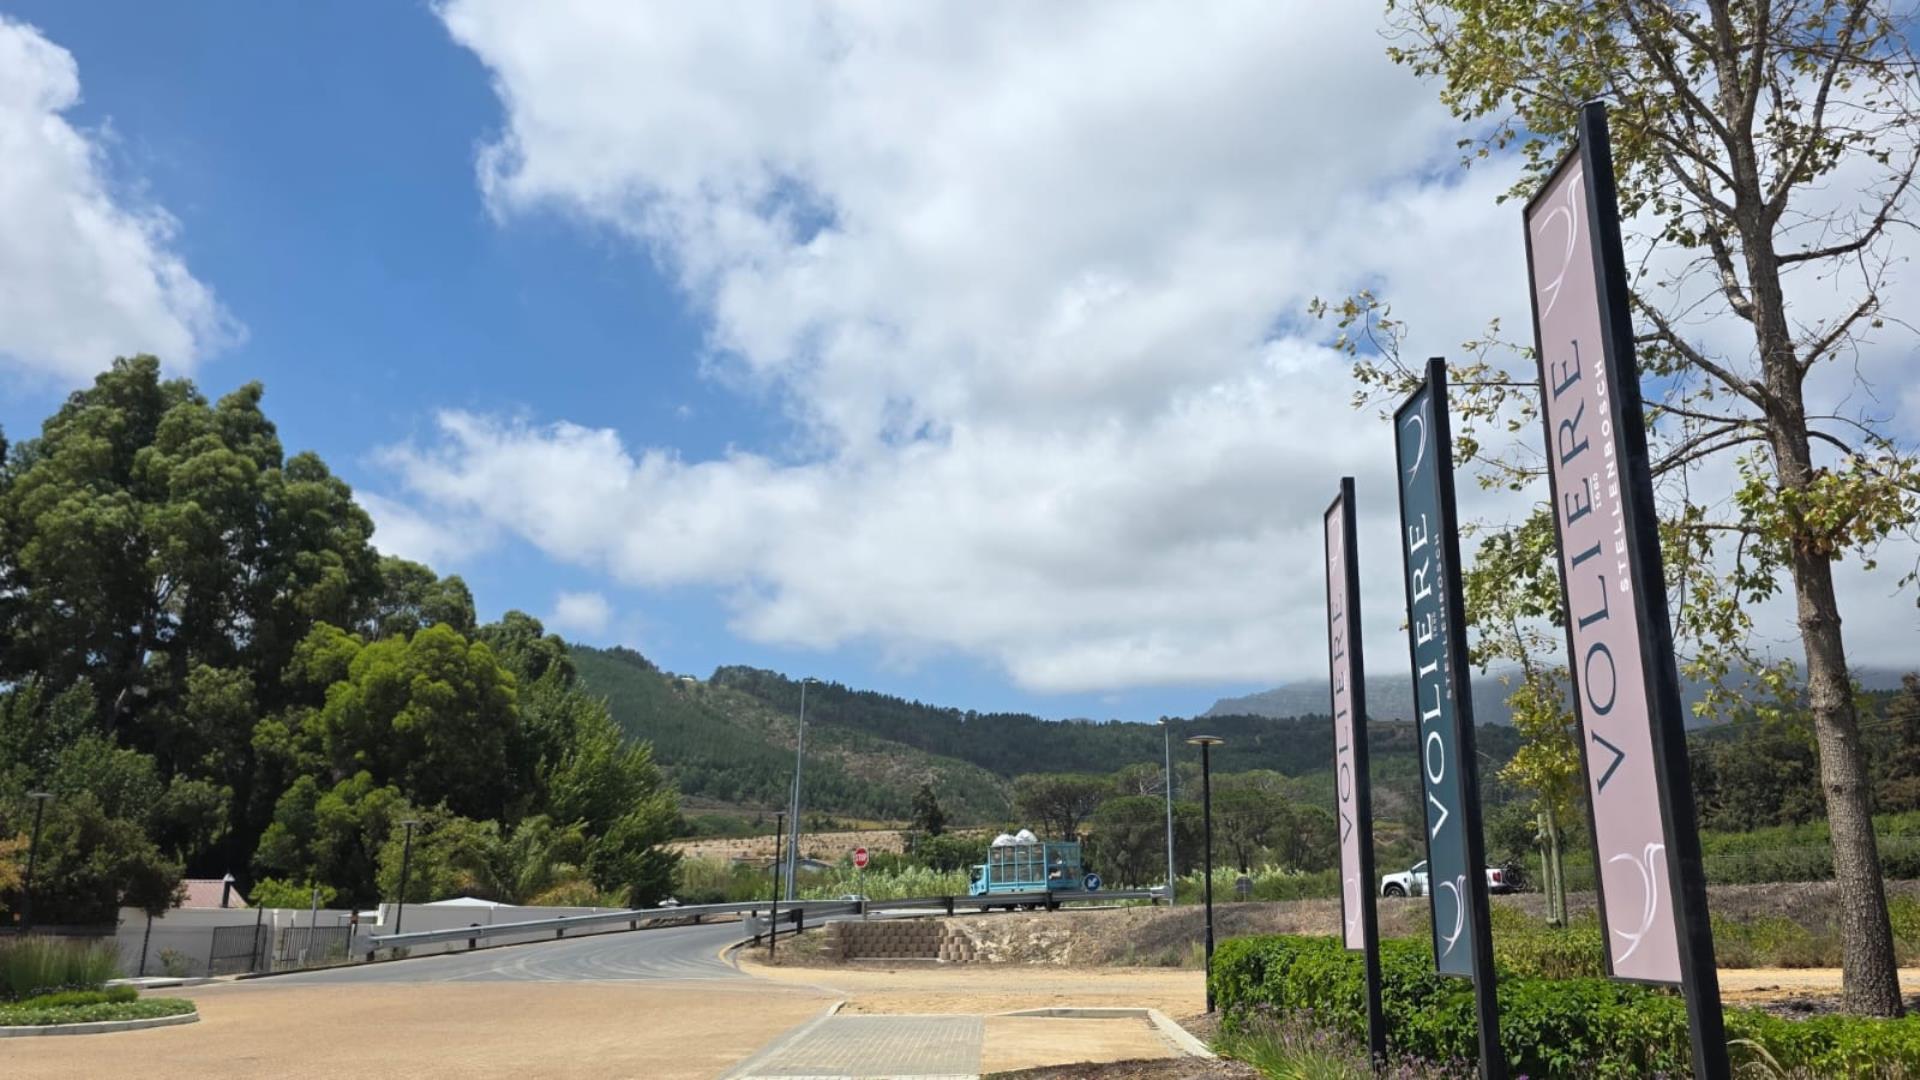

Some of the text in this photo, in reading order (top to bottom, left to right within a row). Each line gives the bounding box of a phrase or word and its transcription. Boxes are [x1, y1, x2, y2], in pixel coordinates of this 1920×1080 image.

[1551, 338, 1625, 794] VOLIERE
[1594, 360, 1630, 592] STELLENBOSCH
[1332, 592, 1353, 844] VOLIERE
[1409, 513, 1449, 839] VOLIERE
[854, 853, 868, 862] STOP
